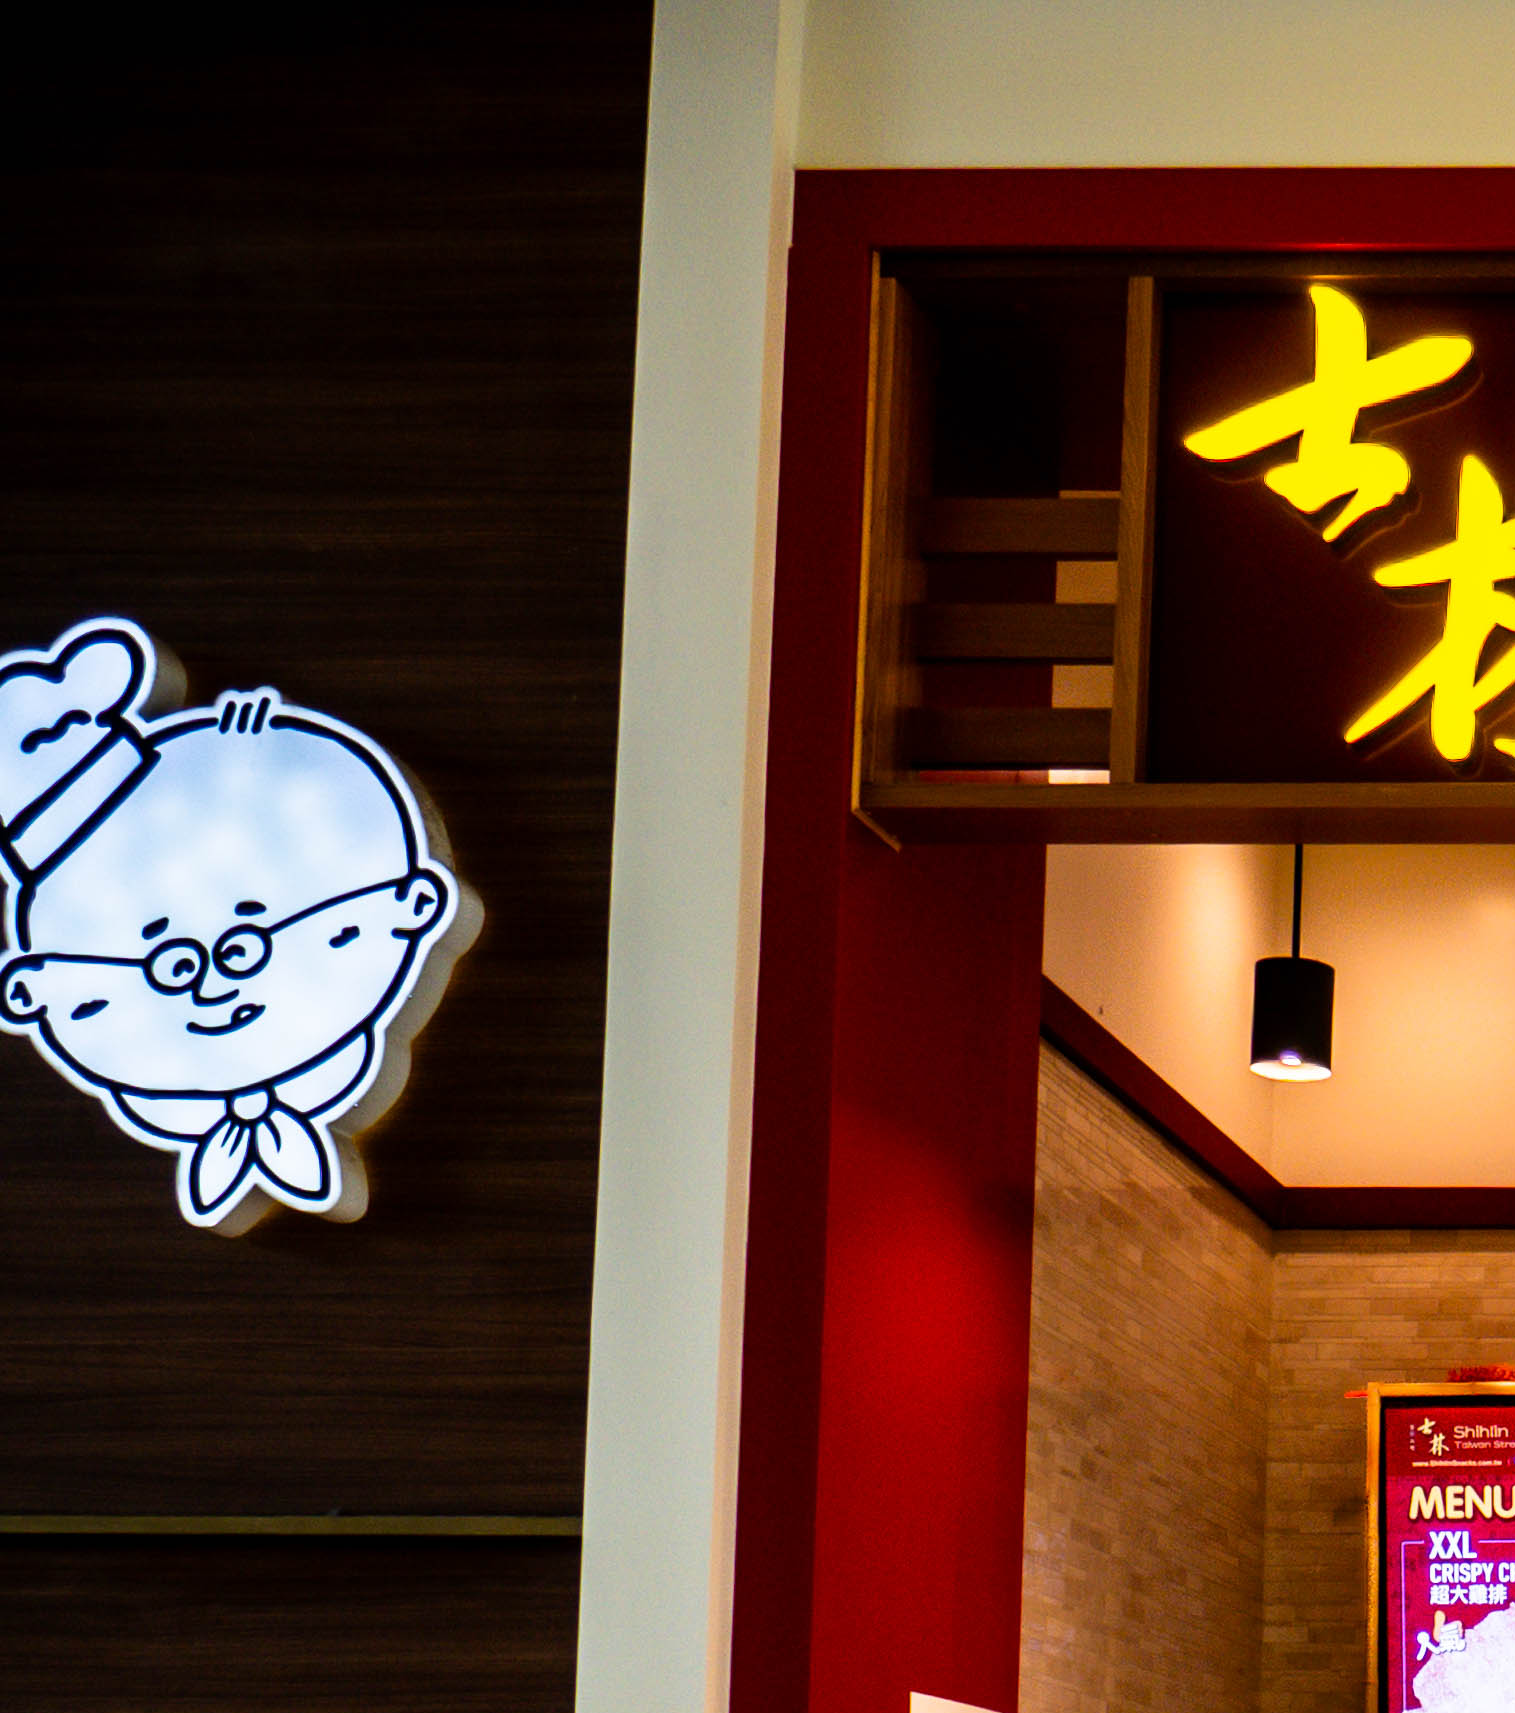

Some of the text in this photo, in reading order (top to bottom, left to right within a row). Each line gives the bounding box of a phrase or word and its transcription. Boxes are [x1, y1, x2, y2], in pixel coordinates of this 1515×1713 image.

[1454, 1425, 1509, 1439] Shihlin
[1429, 1531, 1477, 1559] XXL
[1429, 1563, 1494, 1583] CRISPY
[1430, 1584, 1508, 1605] 超大雞排
